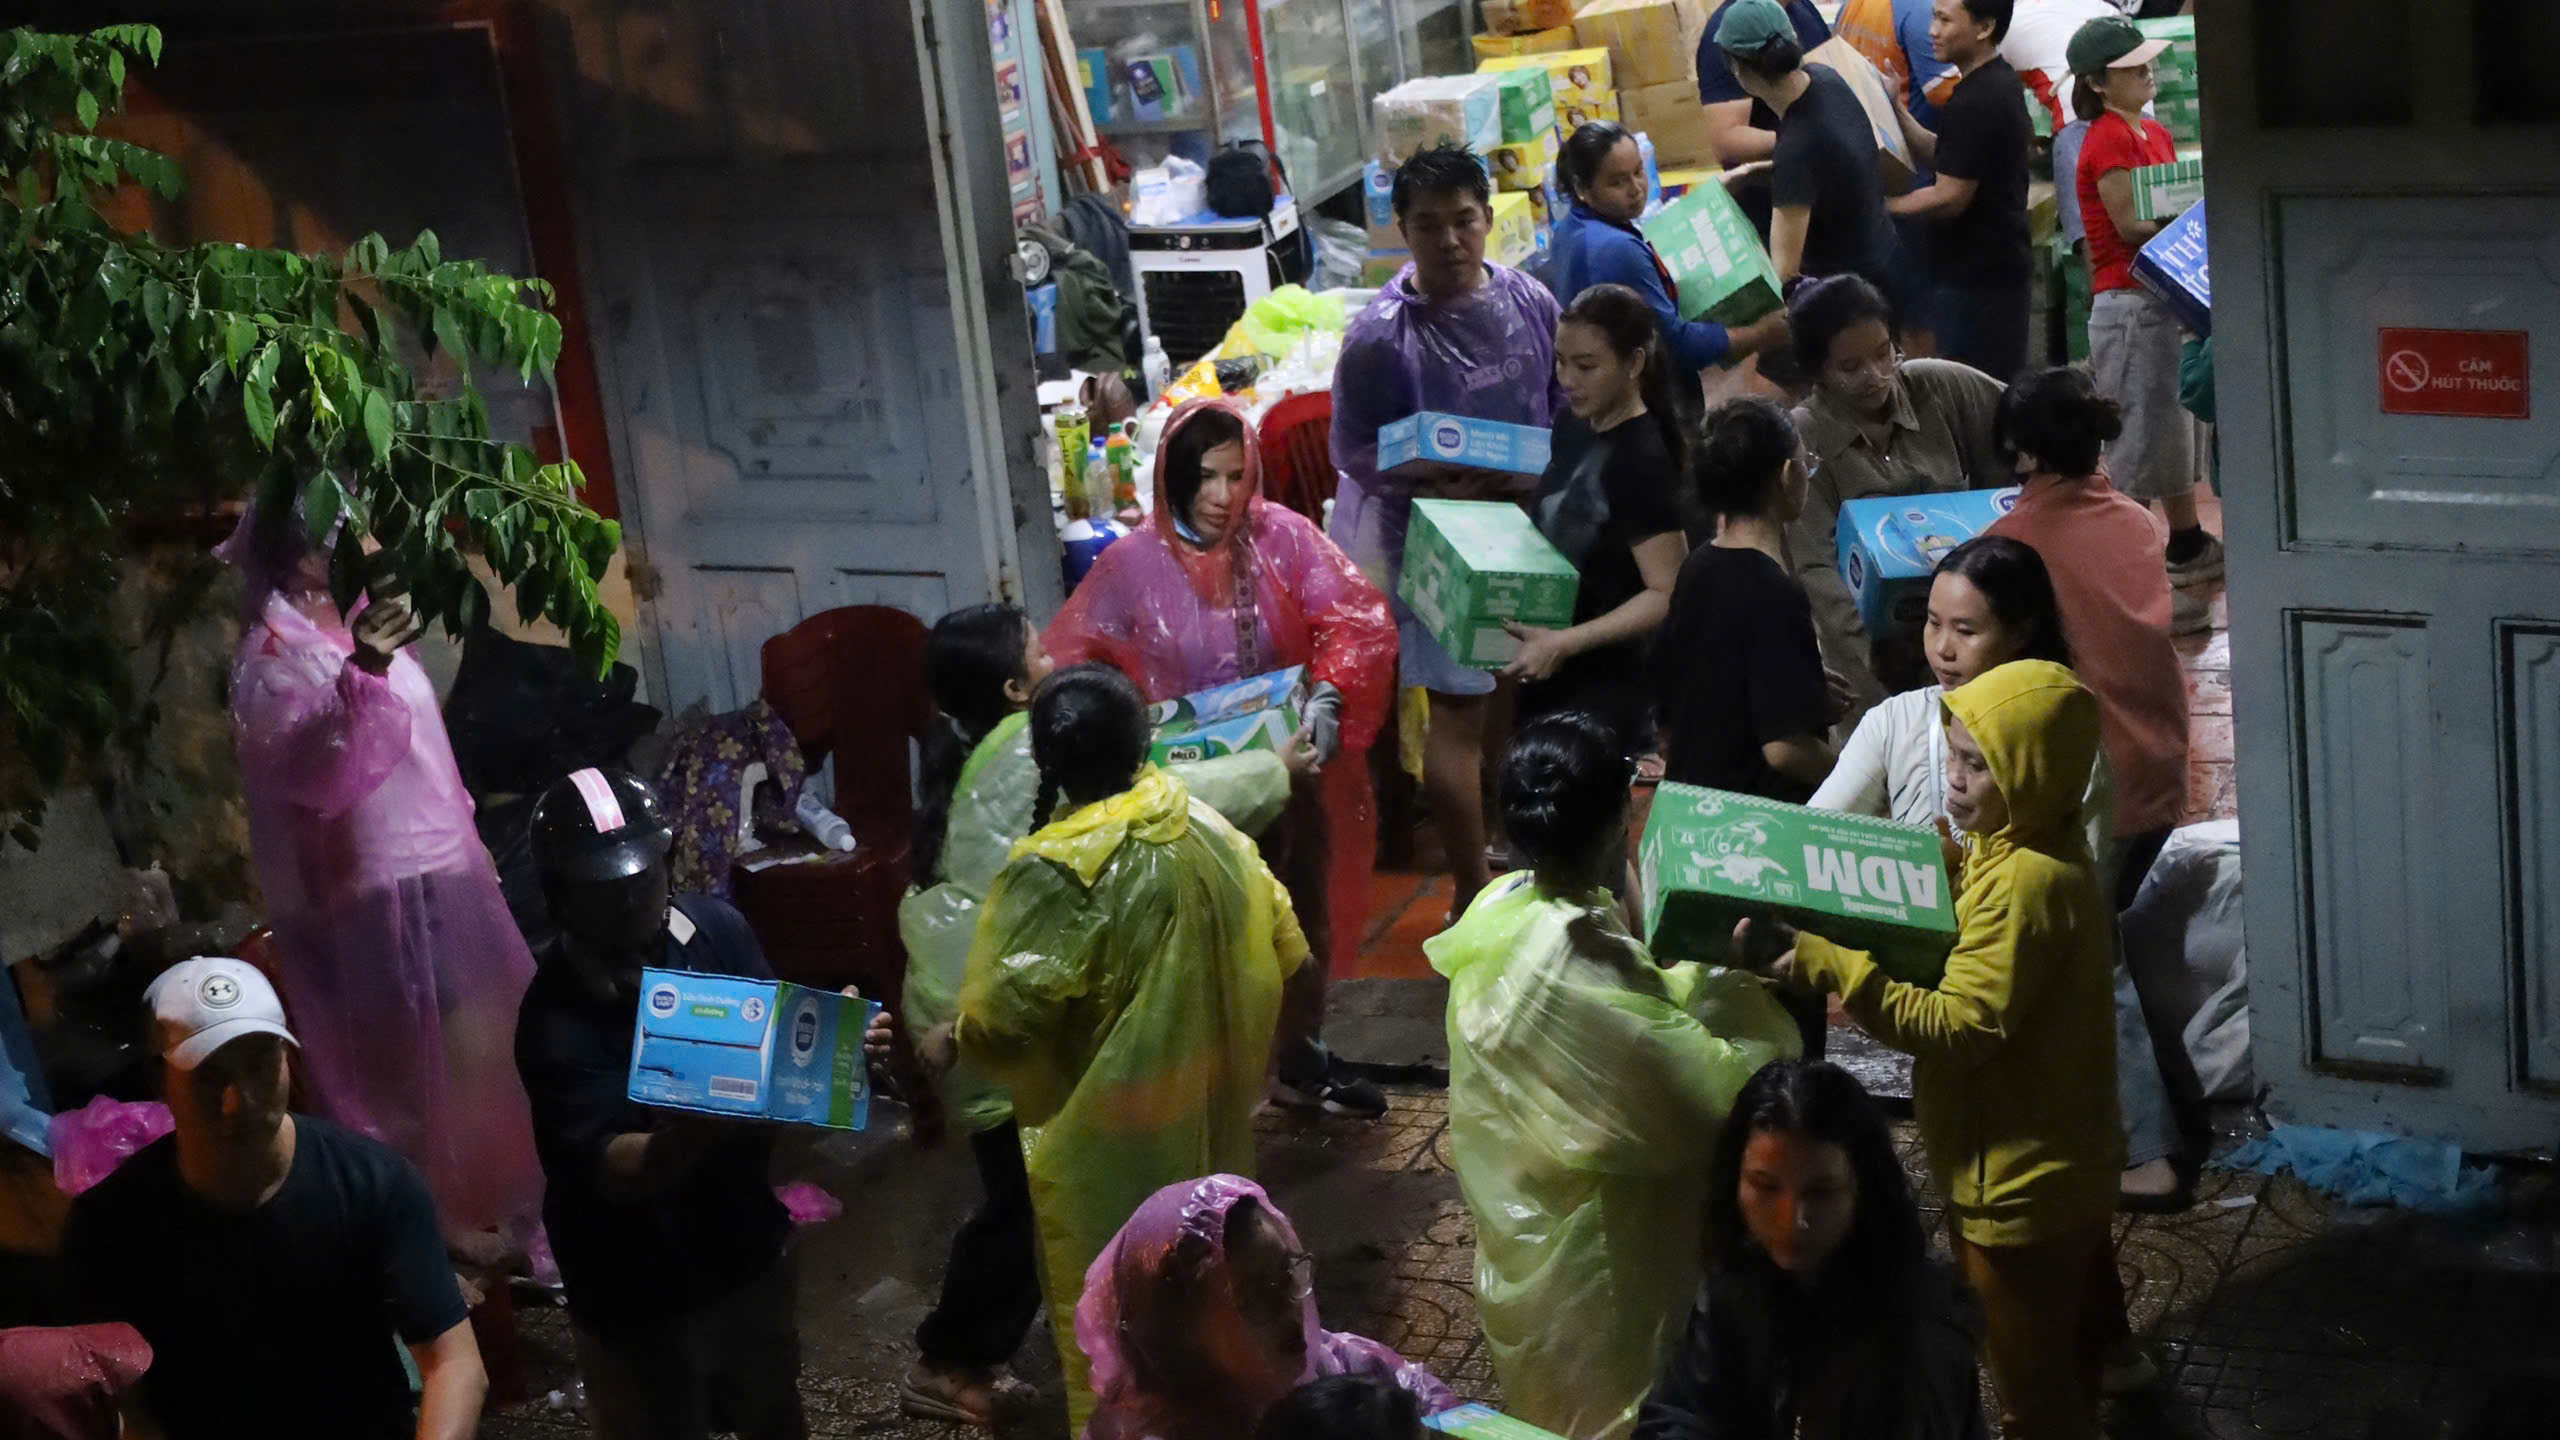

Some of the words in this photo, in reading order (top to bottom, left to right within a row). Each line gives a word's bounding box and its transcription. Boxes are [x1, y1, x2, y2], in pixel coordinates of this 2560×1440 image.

[2164, 235, 2205, 269] TH
[2431, 372, 2464, 391] HÚT
[2468, 374, 2521, 392] THUỐC
[1802, 843, 1938, 910] ADM
